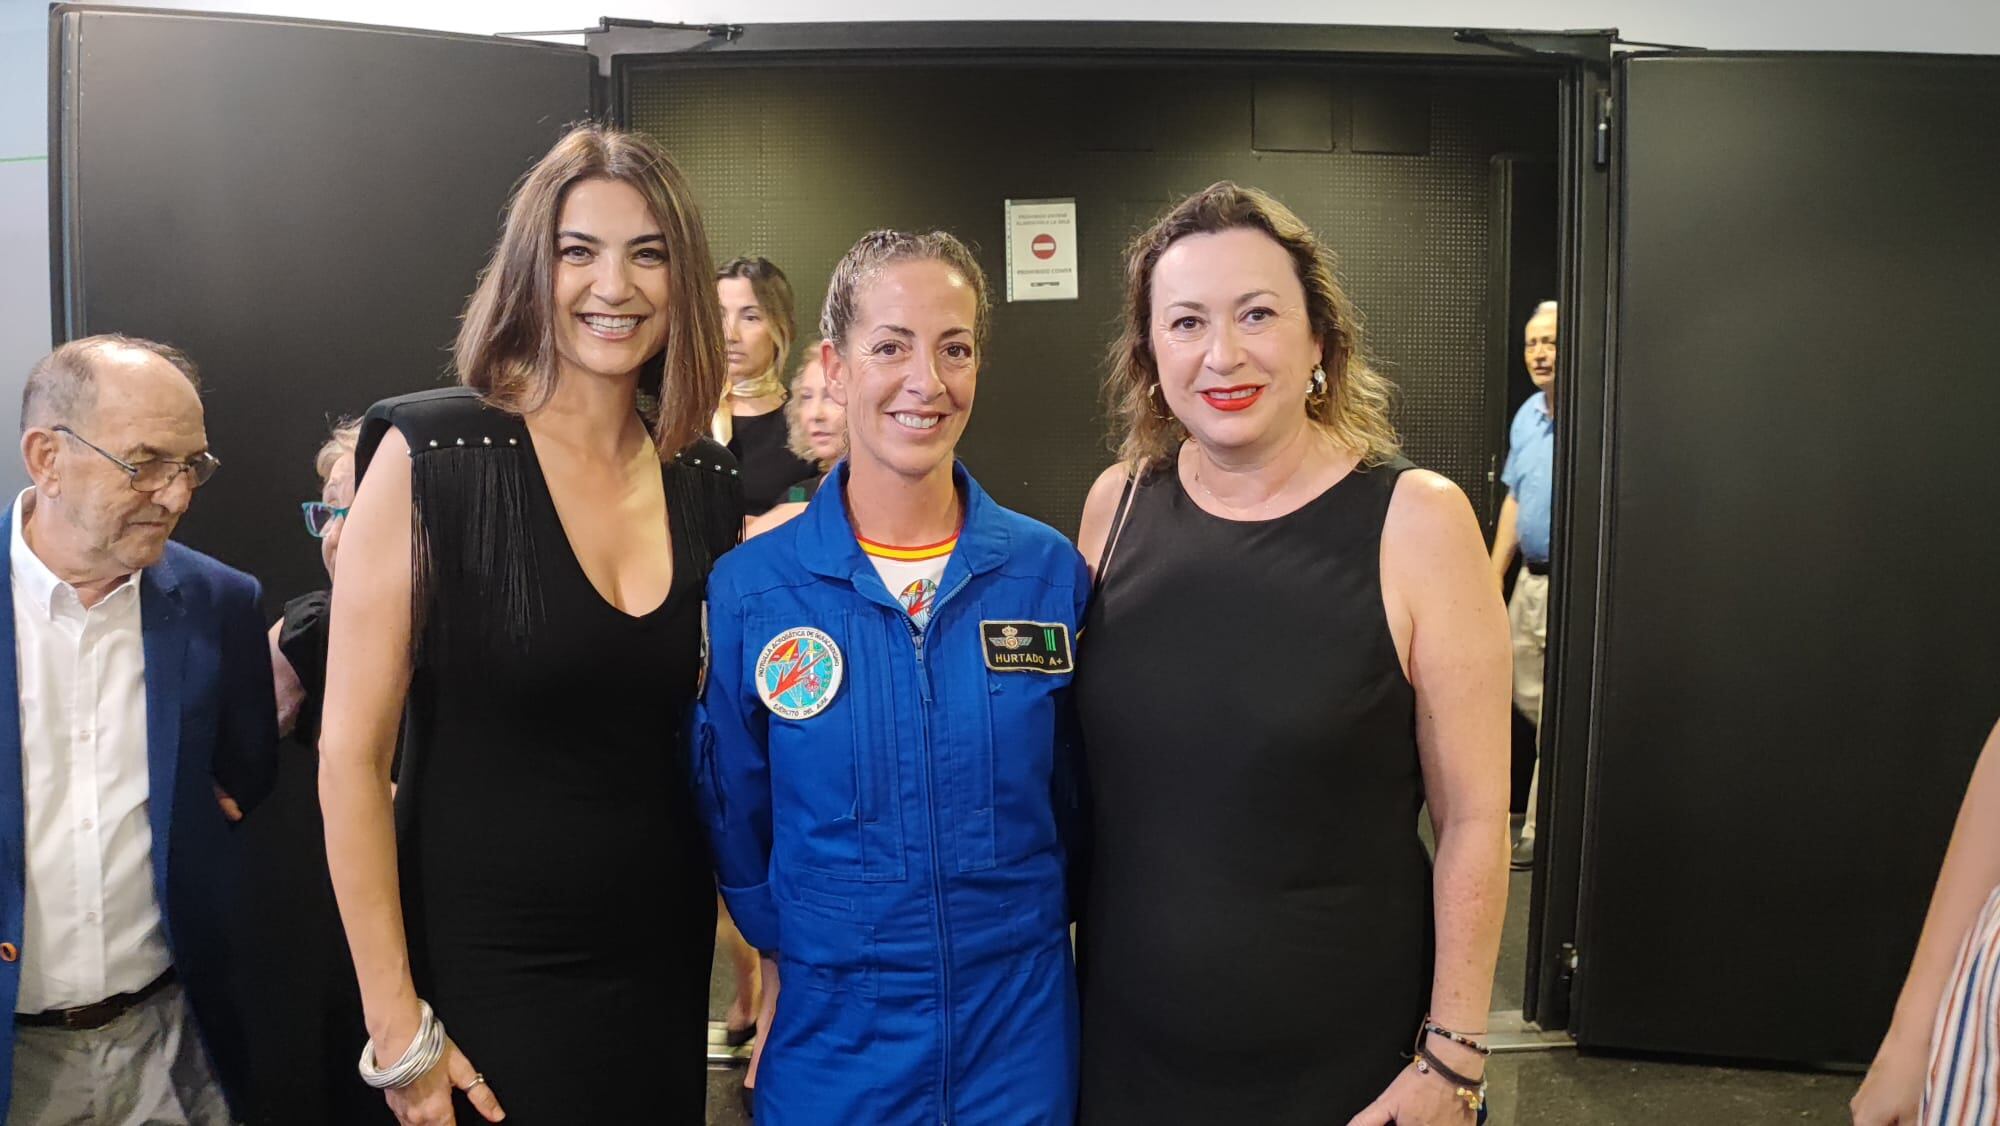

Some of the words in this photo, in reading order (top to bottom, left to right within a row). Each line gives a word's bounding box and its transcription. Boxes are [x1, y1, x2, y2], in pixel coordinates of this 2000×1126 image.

[807, 630, 815, 638] DE
[995, 652, 1044, 664] HURTADO
[1048, 656, 1063, 666] A+
[803, 707, 814, 716] DEL
